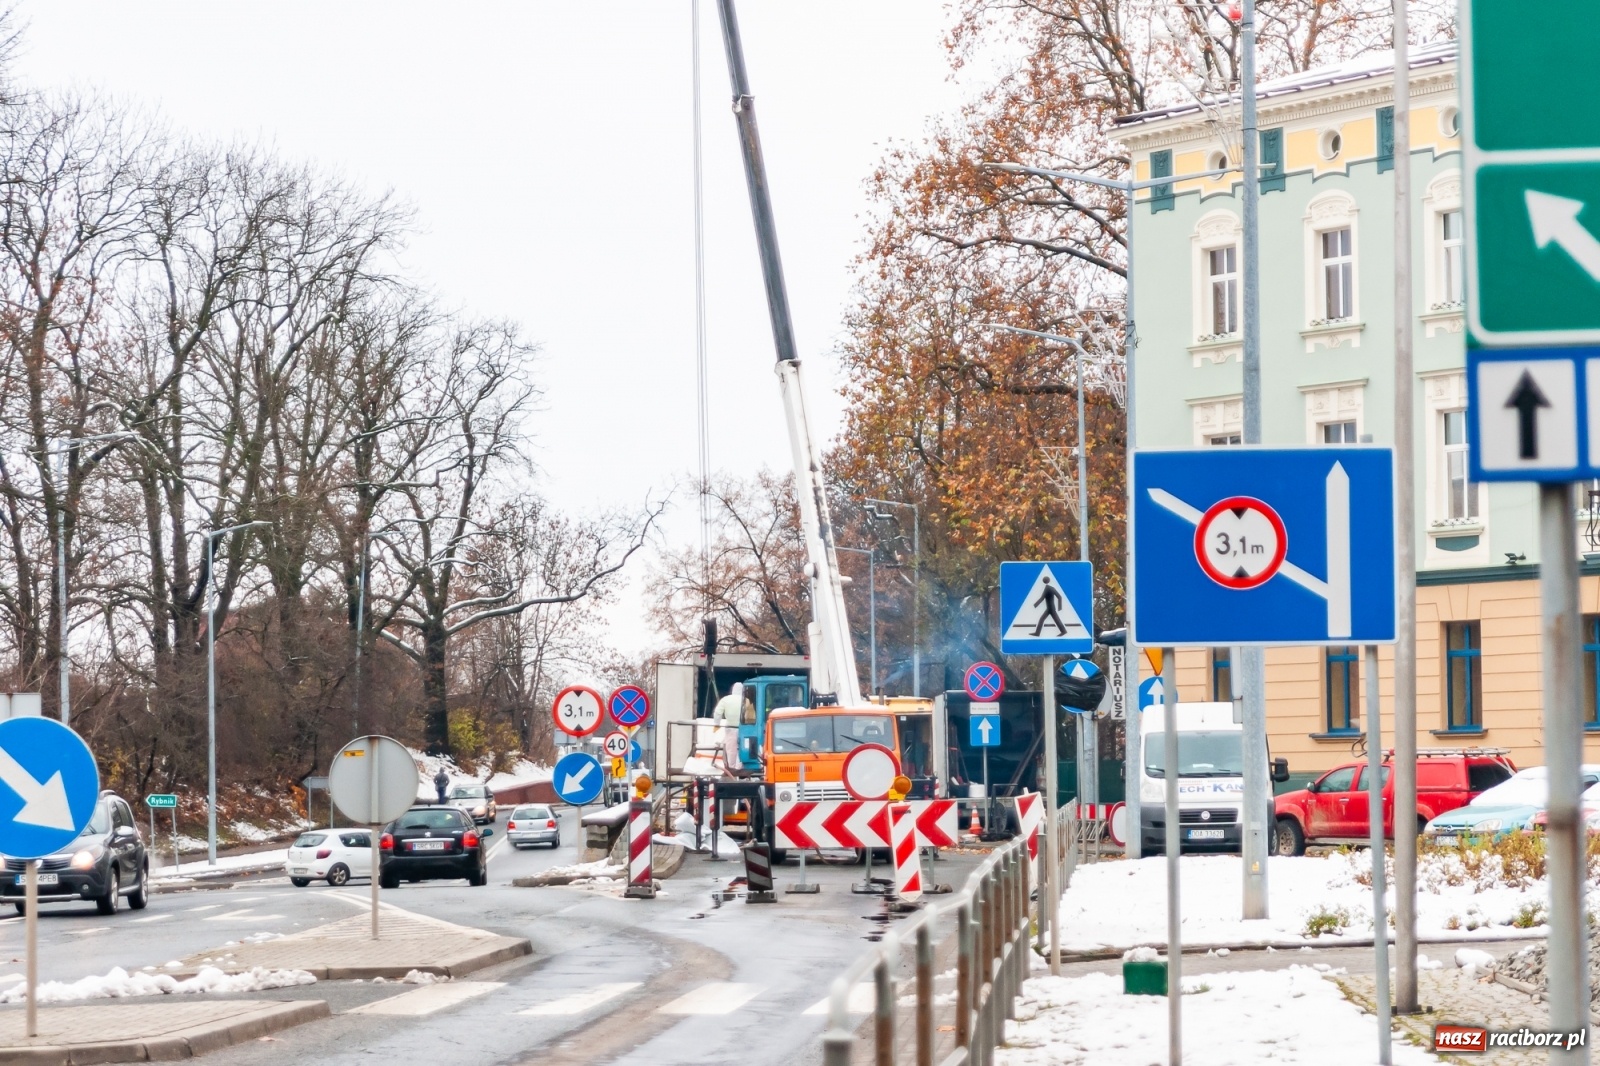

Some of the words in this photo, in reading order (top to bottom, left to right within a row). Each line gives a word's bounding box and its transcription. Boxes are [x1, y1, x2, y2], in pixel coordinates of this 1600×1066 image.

[1216, 532, 1246, 557] 3,1
[1251, 544, 1264, 554] m
[1112, 648, 1123, 718] NOTARIUSZ
[564, 704, 583, 718] 3,1
[607, 738, 626, 750] 40
[151, 797, 174, 805] Rybnik
